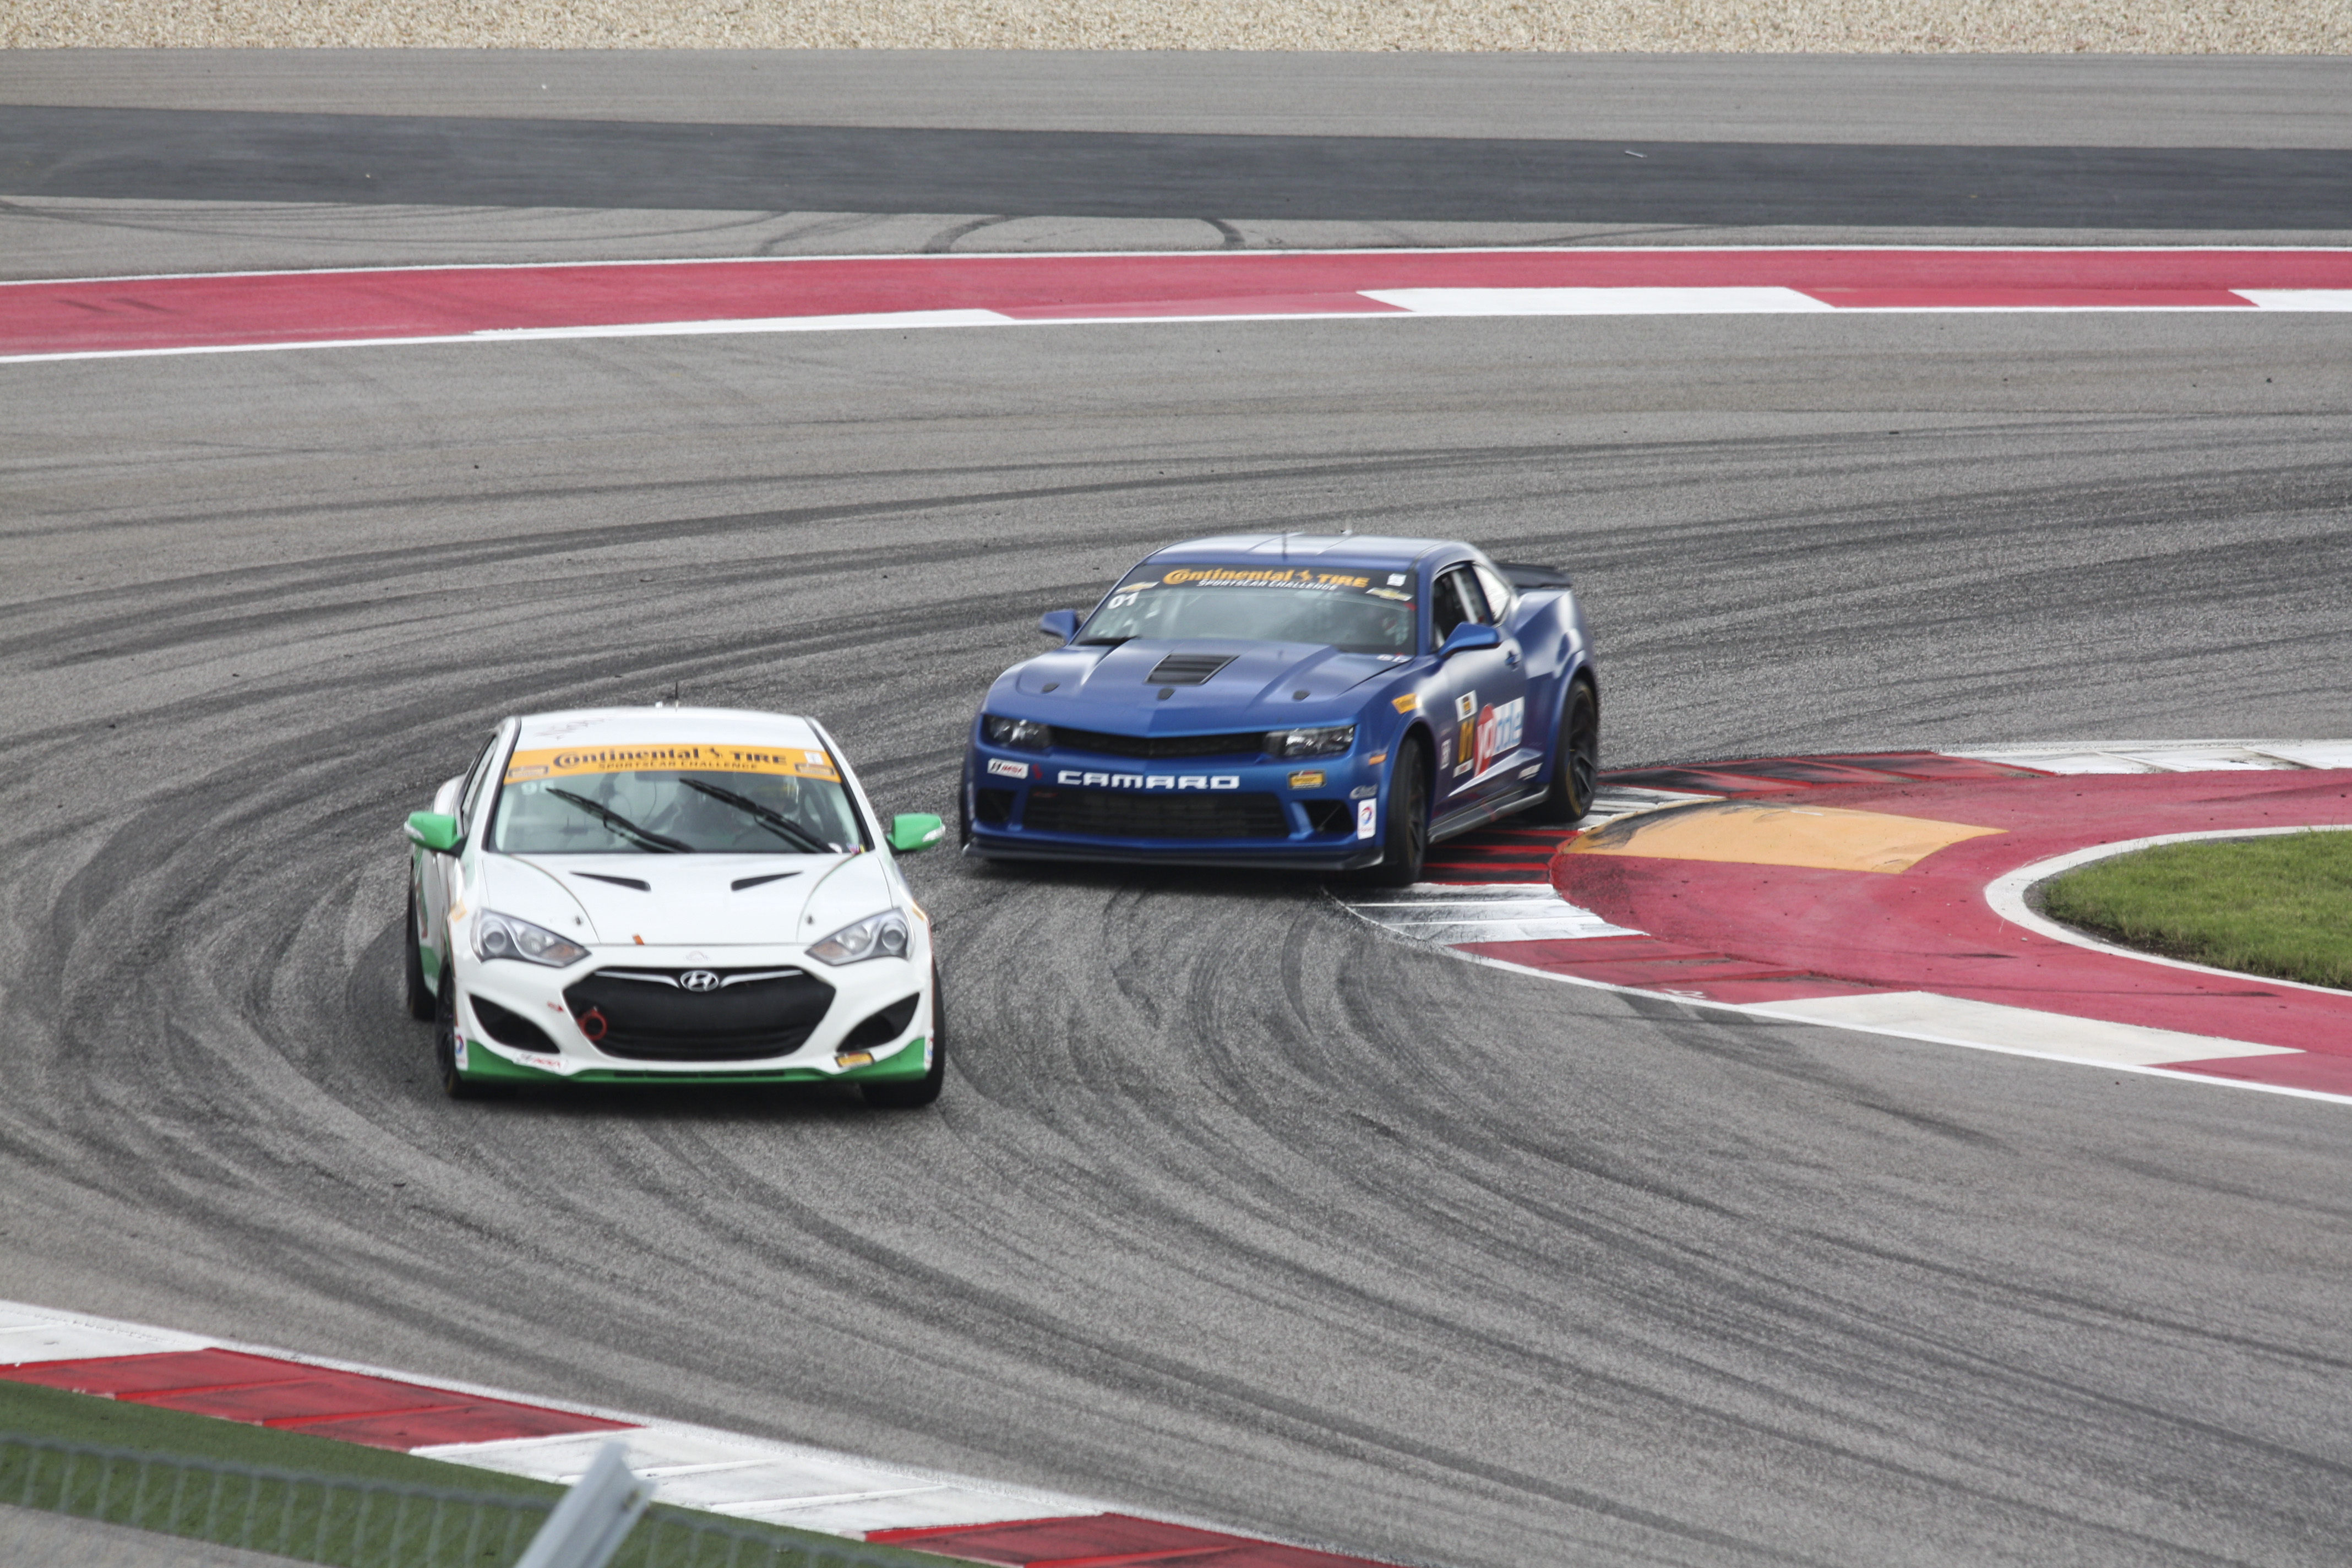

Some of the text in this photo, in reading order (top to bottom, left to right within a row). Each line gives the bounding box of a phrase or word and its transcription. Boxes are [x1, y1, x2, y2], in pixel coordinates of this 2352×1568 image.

[1163, 568, 1295, 585] Continental
[1317, 573, 1370, 587] TIRE
[1196, 579, 1338, 591] SPORTSCAR CHALLENGE
[1107, 592, 1139, 609] 01
[553, 748, 699, 769] Continental
[729, 750, 787, 765] TIRE
[1057, 770, 1240, 790] CAMARO
